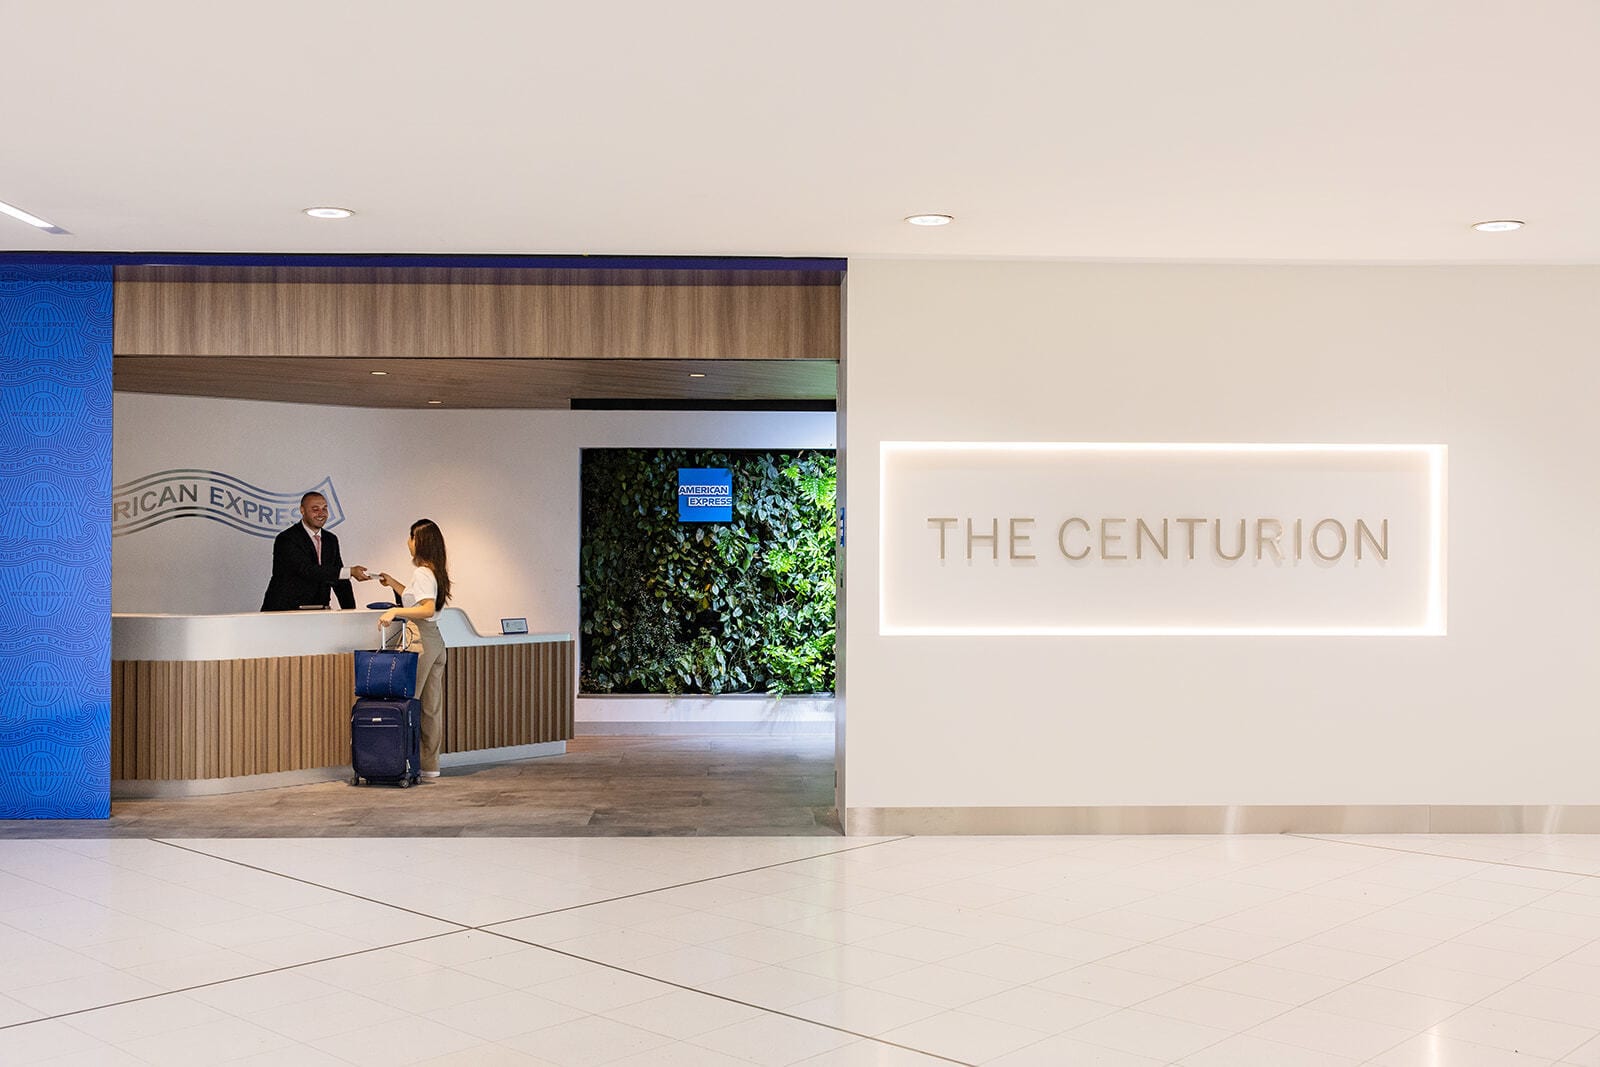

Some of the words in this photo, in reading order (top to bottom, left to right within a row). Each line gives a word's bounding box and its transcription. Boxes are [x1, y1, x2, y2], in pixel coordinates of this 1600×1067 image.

[49, 368, 93, 380] EXPRESS
[49, 457, 92, 471] EXPRESS
[679, 485, 729, 495] AMERICAN
[688, 497, 732, 506] EXPRESS
[927, 517, 1036, 560] THE
[1057, 517, 1389, 561] CENTURION
[48, 547, 91, 560] EXPRESS
[48, 637, 90, 650] EXPRESS
[47, 726, 90, 739] EXPRESS
